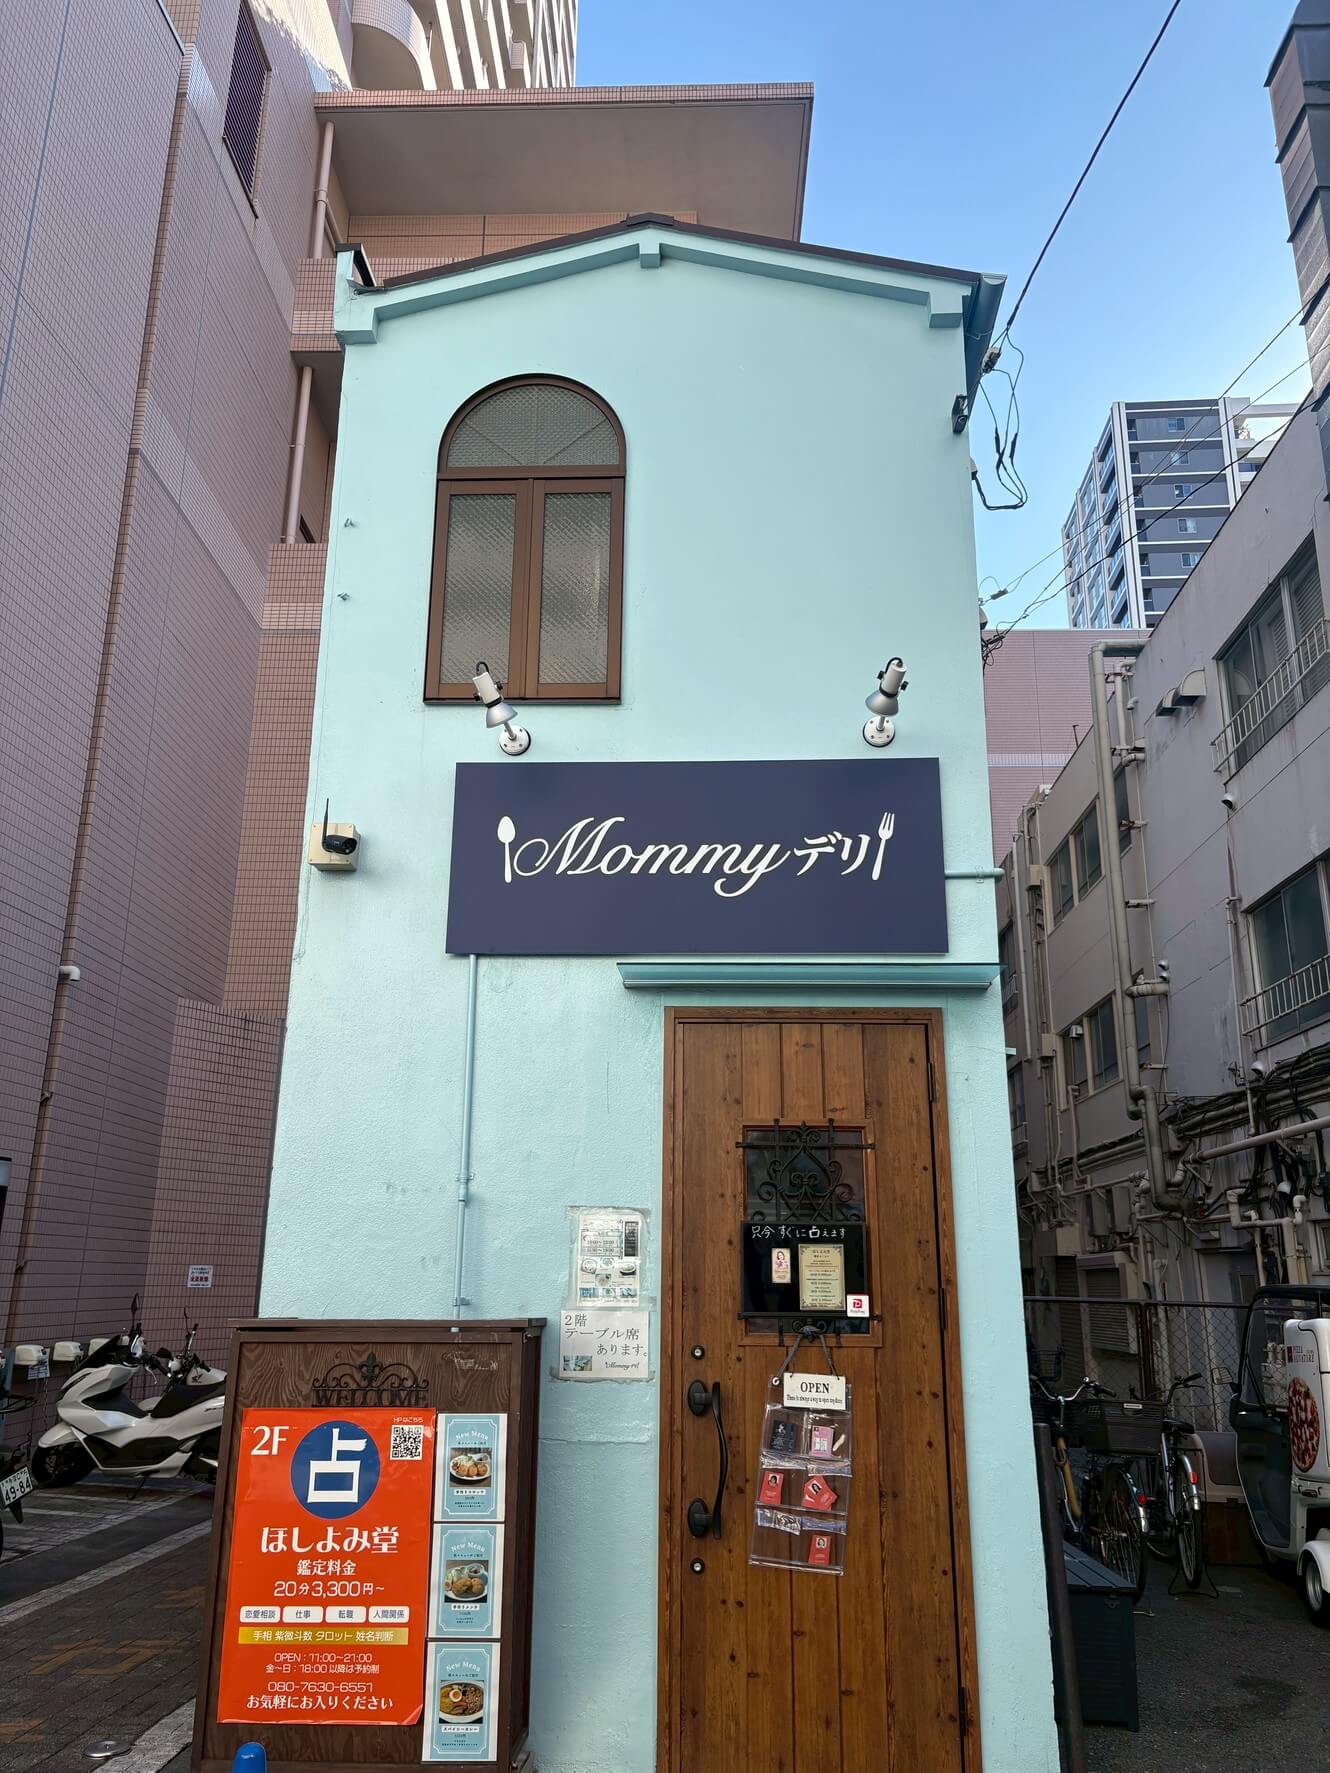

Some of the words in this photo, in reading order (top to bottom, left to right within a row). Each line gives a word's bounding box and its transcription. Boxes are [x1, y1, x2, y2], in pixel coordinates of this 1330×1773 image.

[564, 1314, 588, 1327] 2階
[564, 1327, 641, 1341] テーブル席
[596, 1343, 647, 1357] あります。
[800, 1381, 830, 1393] OPEN
[315, 1389, 428, 1406] WELCOME
[251, 1426, 289, 1456] 2F
[306, 1428, 367, 1504] 占
[261, 1526, 400, 1554] ほしよみ堂
[296, 1559, 357, 1576] 鑑定料金
[244, 1609, 276, 1619] 恋愛相談
[295, 1609, 311, 1619] 仕事
[338, 1609, 354, 1619] 転職
[373, 1609, 405, 1619] 人間関係
[253, 1631, 272, 1641] 手相
[275, 1631, 313, 1641] 紫微斗数
[315, 1631, 352, 1641] タロット
[355, 1631, 394, 1642] 姓名判断
[267, 1682, 374, 1693] 080-7630-6551
[246, 1695, 393, 1710] お気軽にお入りください
